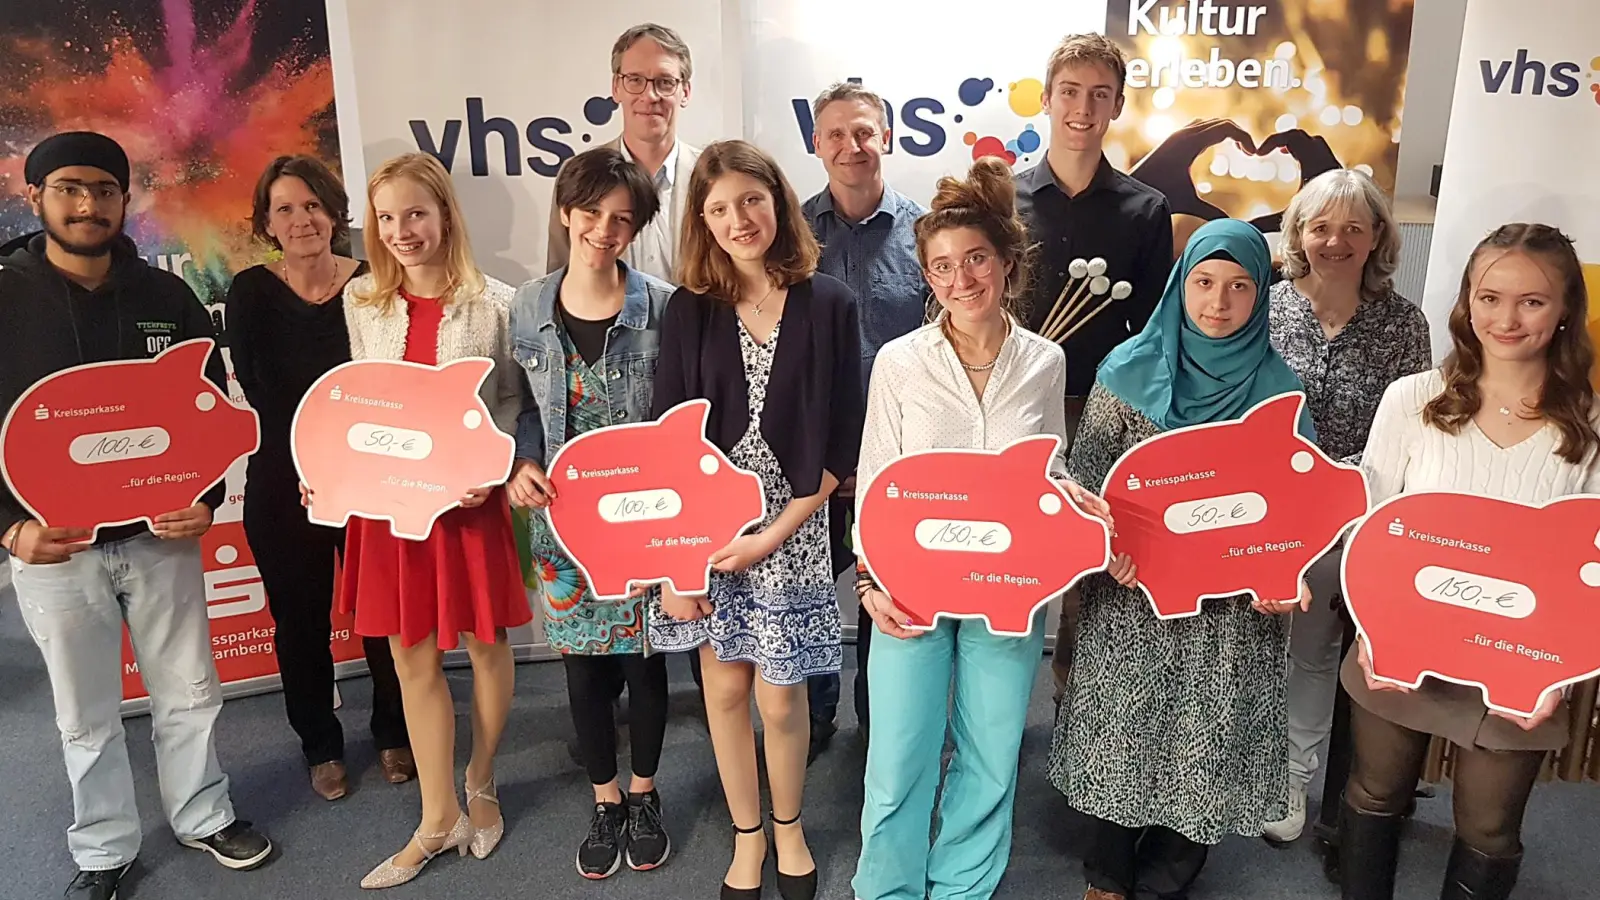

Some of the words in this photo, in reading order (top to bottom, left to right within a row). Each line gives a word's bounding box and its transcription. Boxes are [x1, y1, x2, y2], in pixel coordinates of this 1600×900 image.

[1128, 0, 1267, 36] Kultur
[1125, 48, 1302, 88] erleben.
[1480, 49, 1580, 97] vhs
[409, 97, 573, 177] vhs
[344, 393, 404, 410] Kreissparkasse
[54, 403, 126, 418] Kreissparkasse
[147, 474, 163, 486] die
[164, 470, 201, 486] Region.
[581, 465, 640, 479] Kreissparkasse
[1144, 469, 1216, 487] Kreissparkasse
[402, 478, 416, 488] die
[417, 480, 448, 494] Region.
[902, 489, 969, 502] Kreissparkasse
[666, 537, 679, 547] die
[680, 535, 712, 546] Region.
[1246, 544, 1264, 555] die
[1265, 540, 1305, 553] Region.
[1408, 529, 1492, 555] Kreissparkasse
[986, 573, 1002, 583] die
[1003, 574, 1041, 587] Region.
[1494, 639, 1513, 652] die
[1516, 644, 1563, 665] Region.
